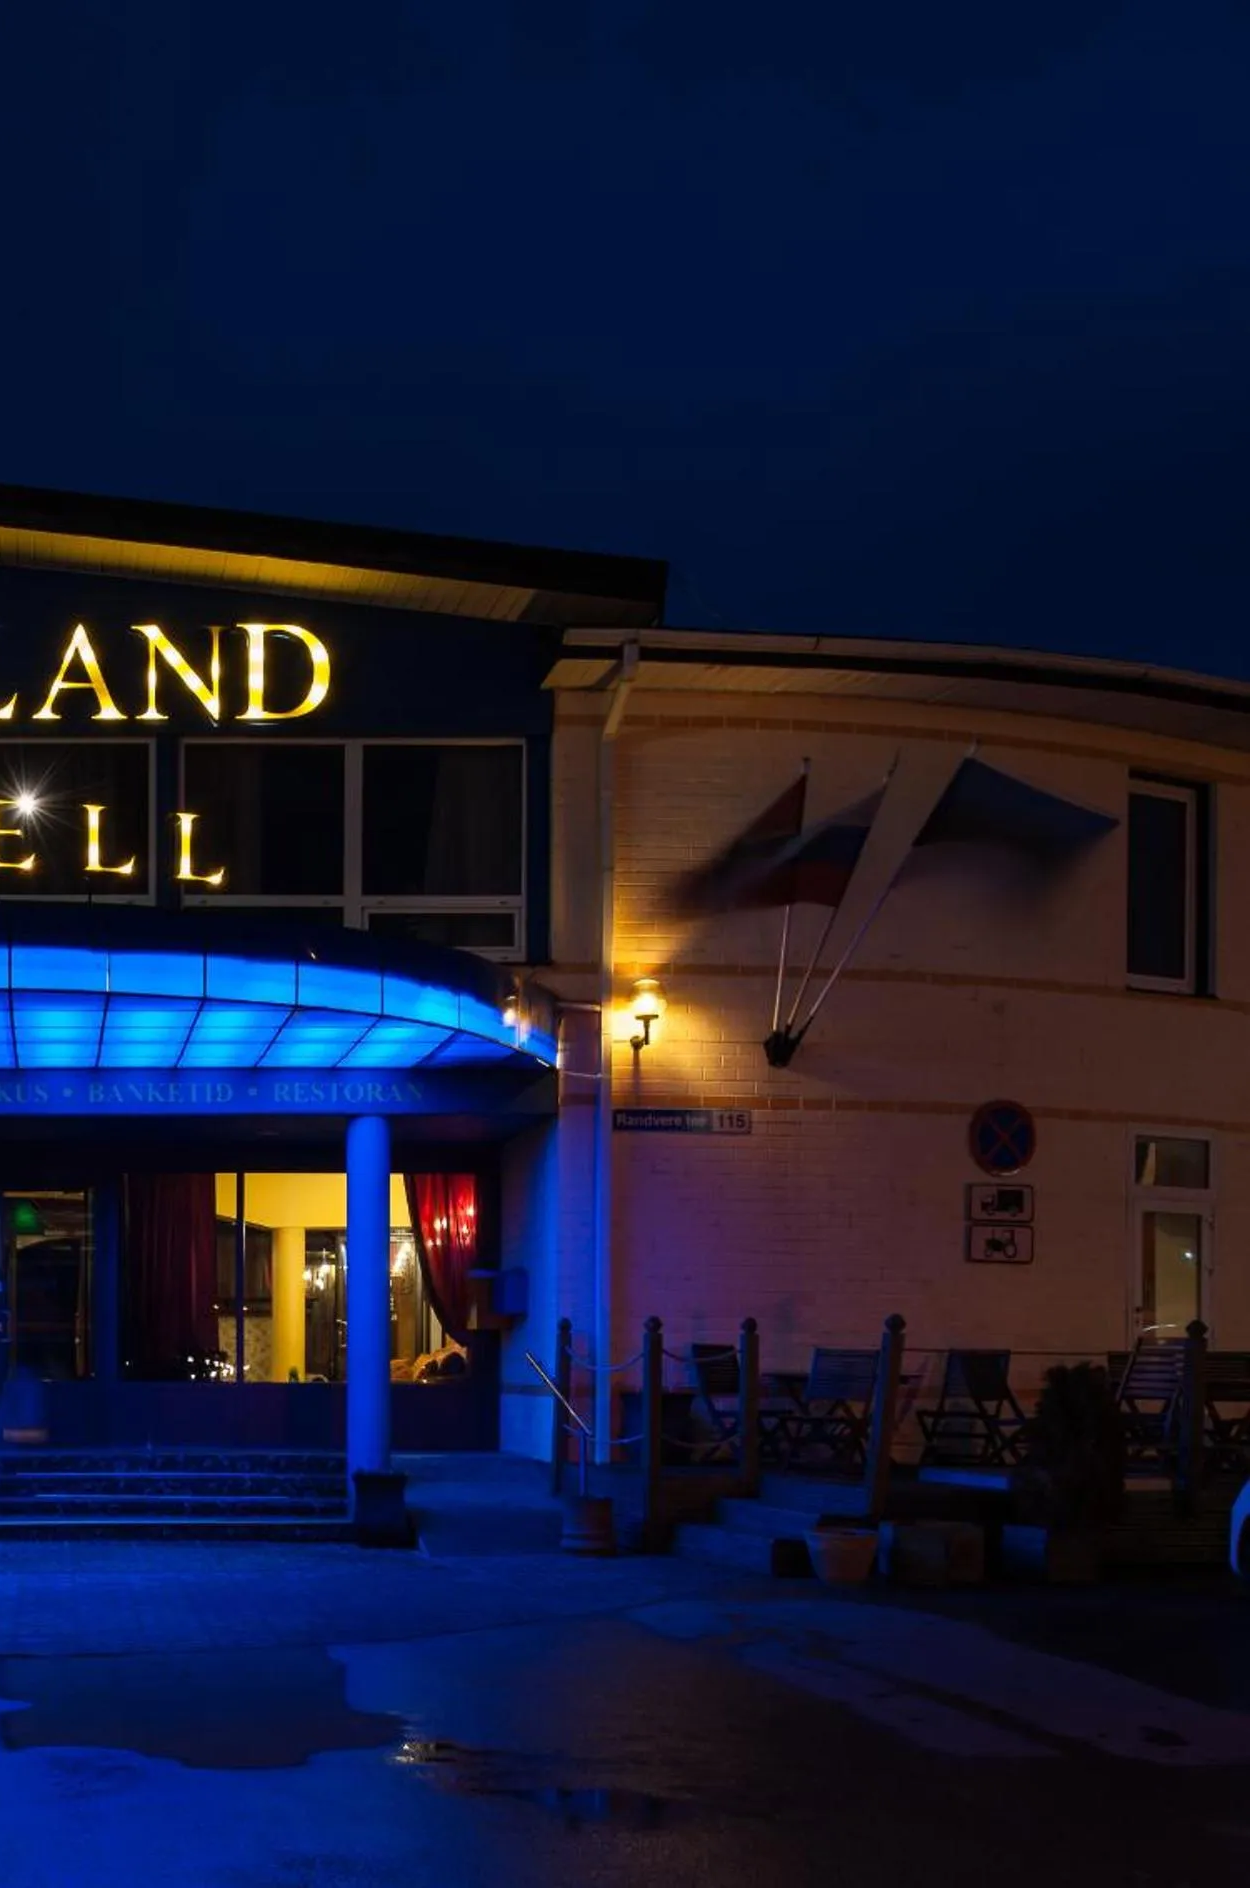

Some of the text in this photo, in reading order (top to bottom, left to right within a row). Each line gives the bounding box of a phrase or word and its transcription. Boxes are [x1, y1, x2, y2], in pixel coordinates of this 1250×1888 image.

[87, 1081, 235, 1104] BANKETID
[273, 1081, 426, 1104] RESTORAN
[718, 1114, 747, 1128] 115
